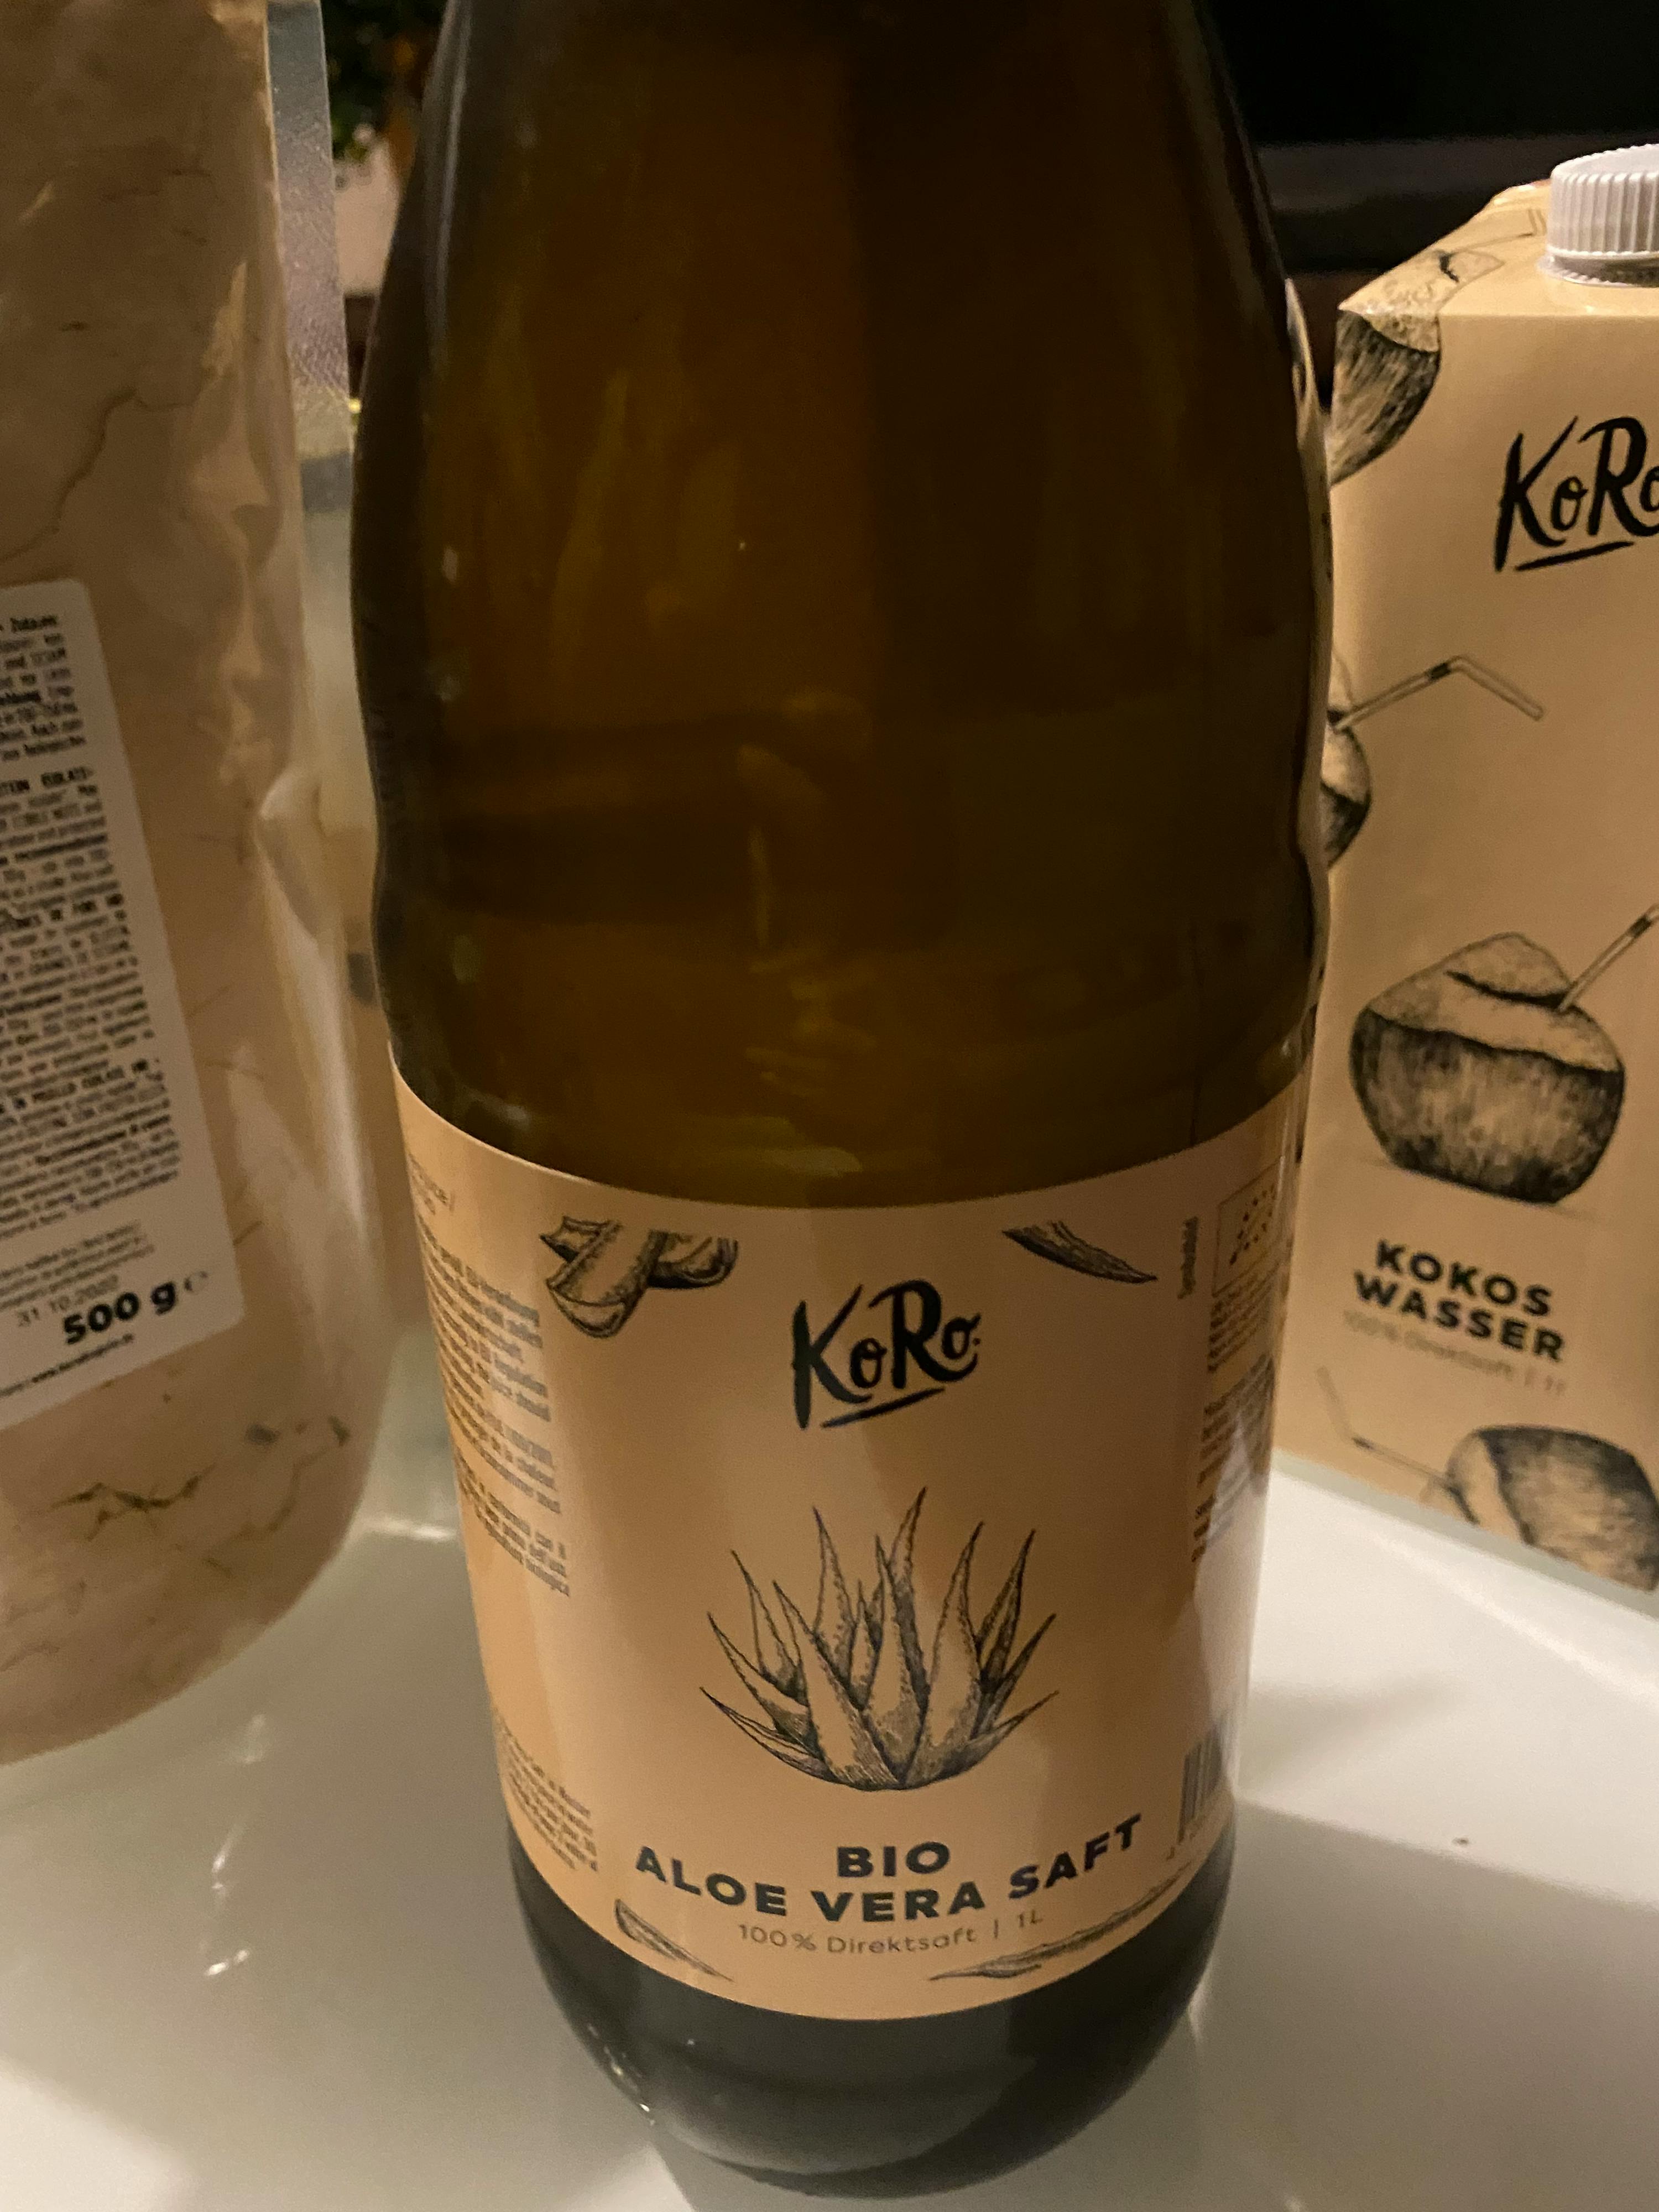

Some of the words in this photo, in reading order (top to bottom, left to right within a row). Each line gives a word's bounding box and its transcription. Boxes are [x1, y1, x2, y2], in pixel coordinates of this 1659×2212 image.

[62, 1292, 139, 1345] 500
[151, 1281, 176, 1313] g
[1354, 1270, 1563, 1362] WASSER
[1376, 1239, 1551, 1317] KOKOS
[791, 1279, 981, 1430] KoRo
[635, 1846, 786, 1916] ALOE
[811, 1881, 985, 1922] VERA
[1008, 1813, 1141, 1898] SAFT
[837, 1841, 950, 1877] BIO
[739, 1923, 817, 1952] 100%
[827, 1926, 977, 1954] Direktsaft
[1018, 1909, 1044, 1928] 1L
